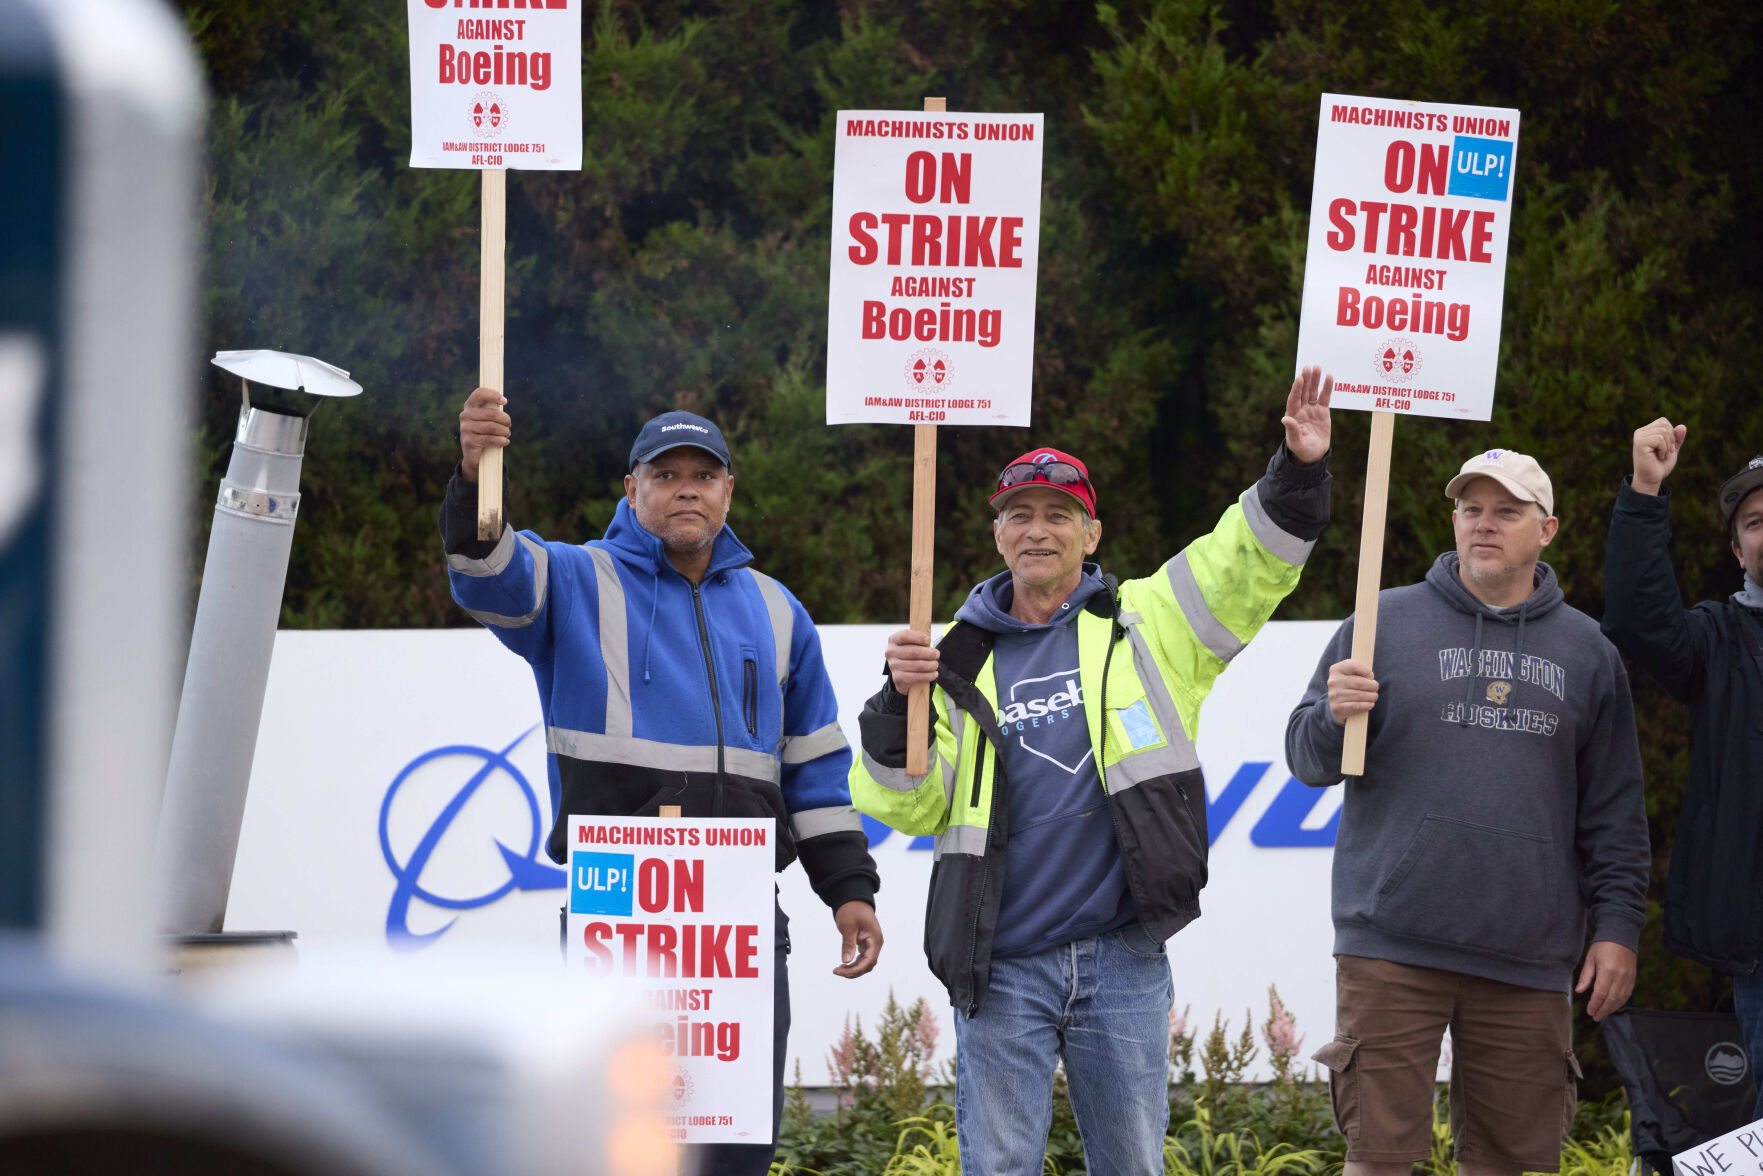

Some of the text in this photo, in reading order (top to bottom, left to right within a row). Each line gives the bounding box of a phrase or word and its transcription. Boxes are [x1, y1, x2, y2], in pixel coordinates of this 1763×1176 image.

[458, 19, 526, 40] AGAINST
[439, 44, 551, 90] Boeing
[847, 120, 1034, 141] MACHINISTS UNION
[1331, 105, 1510, 137] MACHINISTS UNION
[443, 142, 544, 152] IAM&AW DISTRICT LODGE 751
[472, 155, 502, 165] AFL-CIO
[1384, 140, 1449, 196] ON
[1457, 151, 1505, 177] ULP!
[905, 151, 972, 204] ON
[848, 212, 1023, 268] STRIKE
[1327, 198, 1495, 263] STRIKE
[891, 276, 976, 298] AGAINST
[1366, 264, 1447, 290] AGAINST
[862, 301, 1002, 347] Boeing
[1336, 286, 1470, 341] Boeing
[865, 397, 991, 408] IAM&AW DISTRICT LODGE 751
[1335, 383, 1455, 401] IAM&AW DISTRICT LODGE 751
[1376, 398, 1410, 410] AFL-CIO
[662, 423, 705, 432] Southwest
[909, 411, 946, 421] AFL-CIO
[1441, 701, 1558, 736] HUSKIES
[579, 825, 766, 846] MACHINISTS UNION
[578, 866, 627, 892] ULP!
[639, 858, 704, 913] ON
[584, 922, 759, 978] STRIKE
[656, 1016, 740, 1062] eing
[689, 1116, 716, 1126] LODGE
[719, 1116, 732, 1125] 751
[1680, 1143, 1732, 1176] WE
